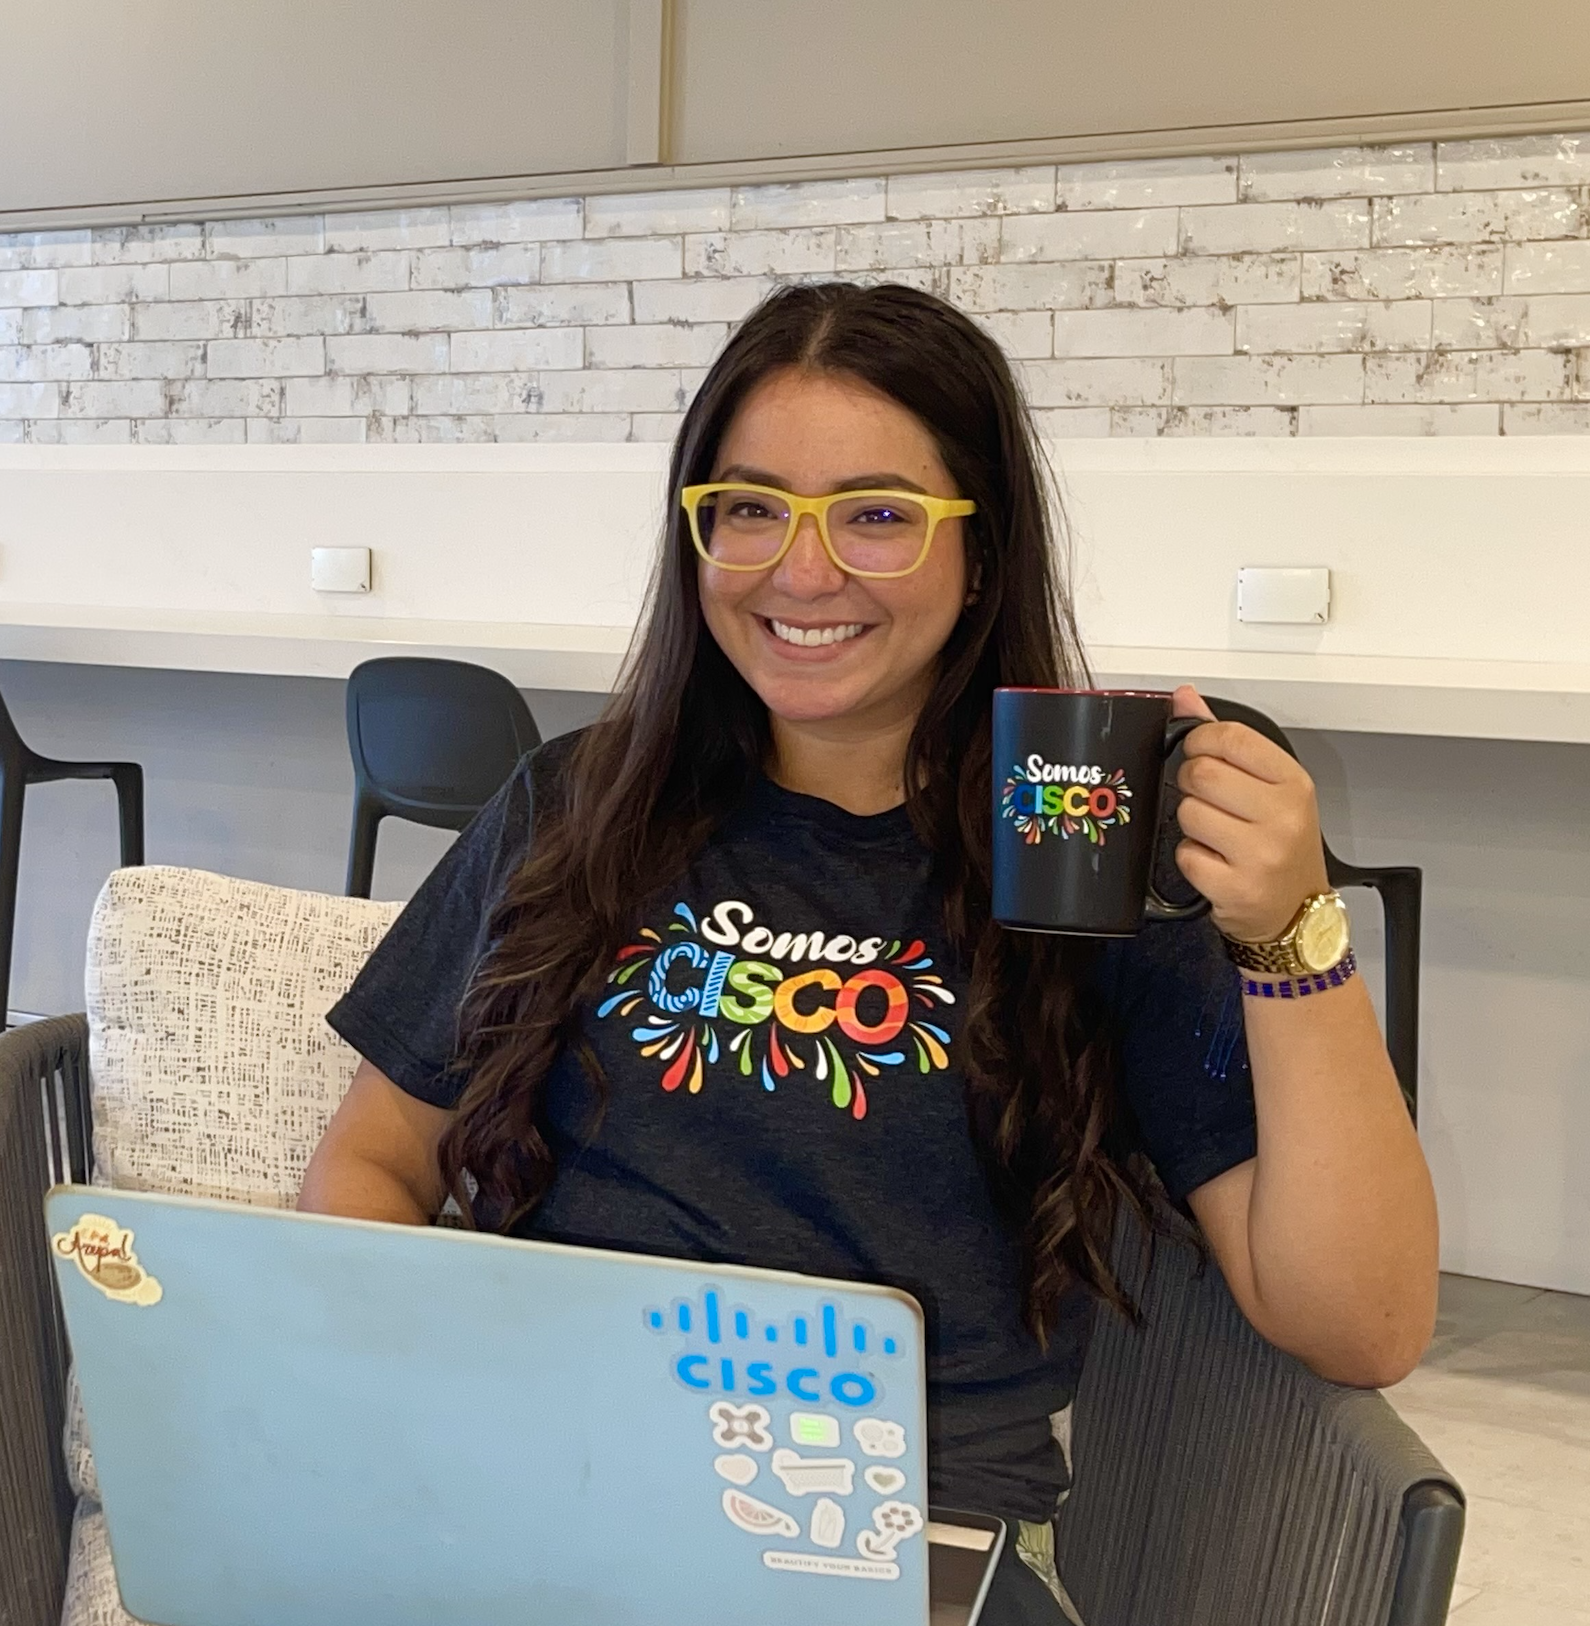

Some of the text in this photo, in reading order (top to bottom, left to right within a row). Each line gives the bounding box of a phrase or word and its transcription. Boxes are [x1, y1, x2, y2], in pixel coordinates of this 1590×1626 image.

[1026, 754, 1105, 785] Somos
[1013, 784, 1117, 818] CISCO
[701, 900, 887, 965] Somos
[648, 941, 910, 1045] CISCO
[676, 1354, 876, 1407] CISCO
[822, 1562, 851, 1572] YOUR
